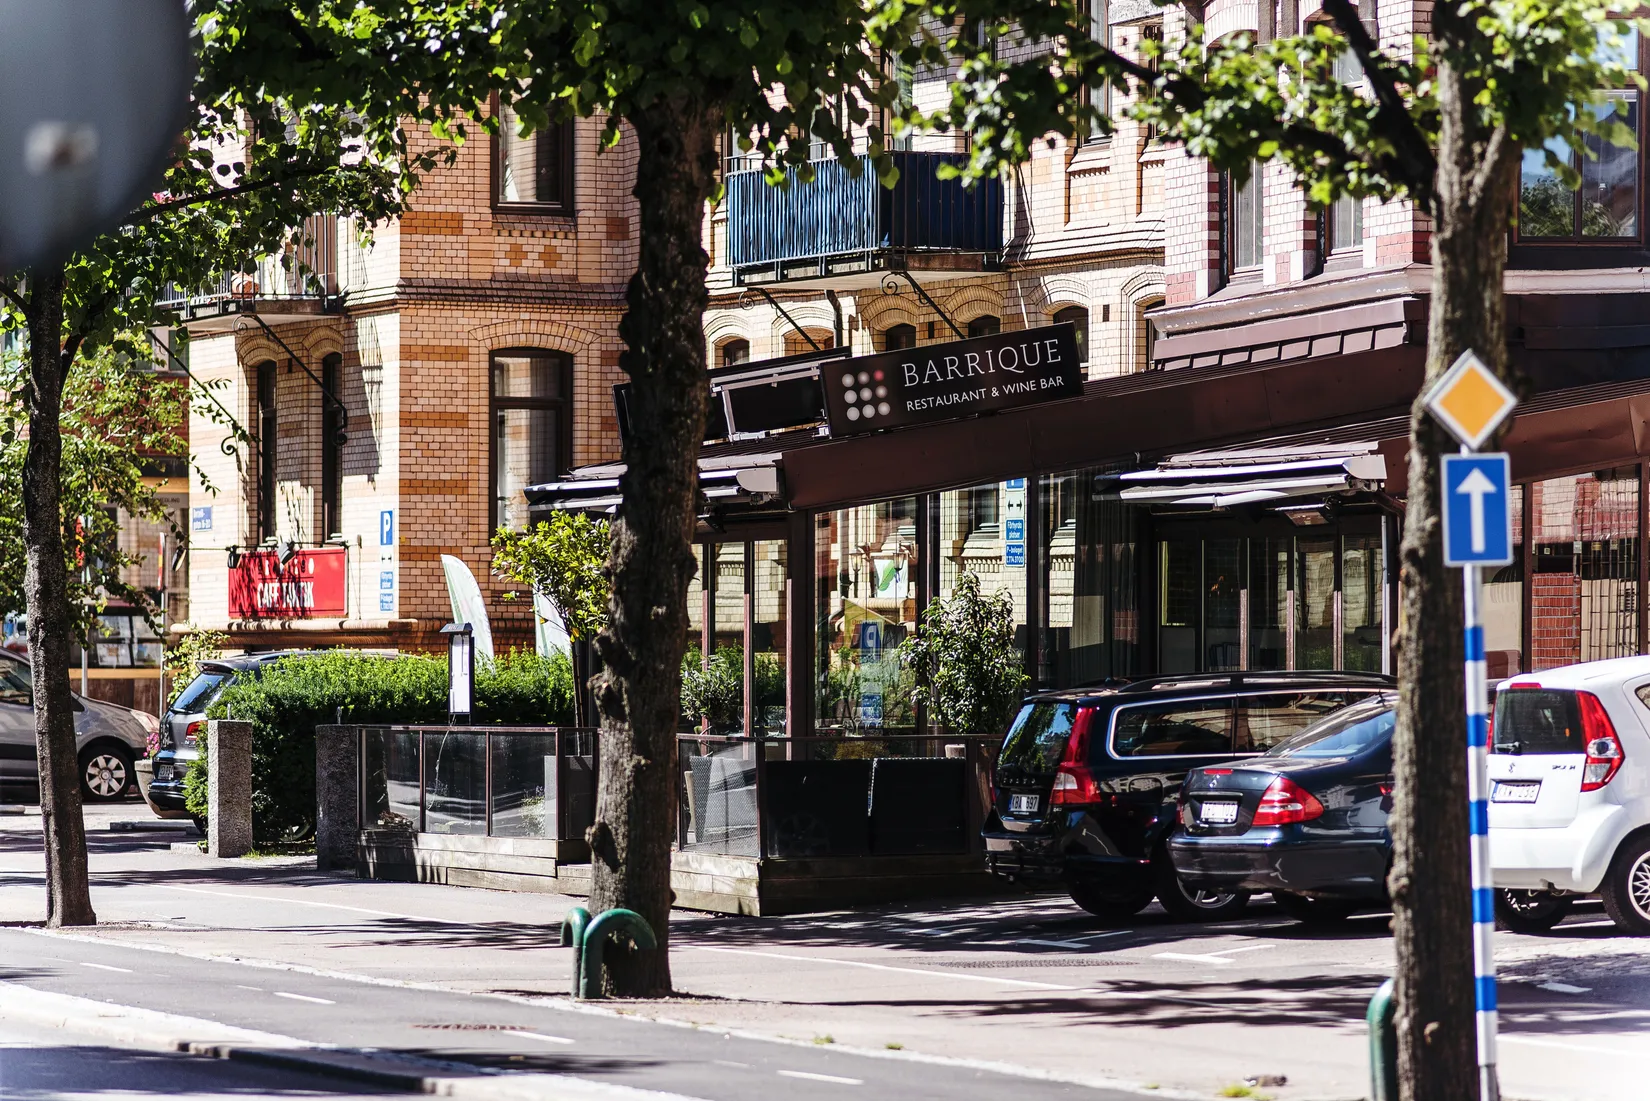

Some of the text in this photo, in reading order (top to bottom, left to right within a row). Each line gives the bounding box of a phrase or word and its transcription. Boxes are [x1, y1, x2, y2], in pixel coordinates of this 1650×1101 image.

[901, 338, 1062, 387] BARRIQUE
[906, 375, 1064, 411] RESTAURANT & WINE BAR
[383, 512, 391, 544] P
